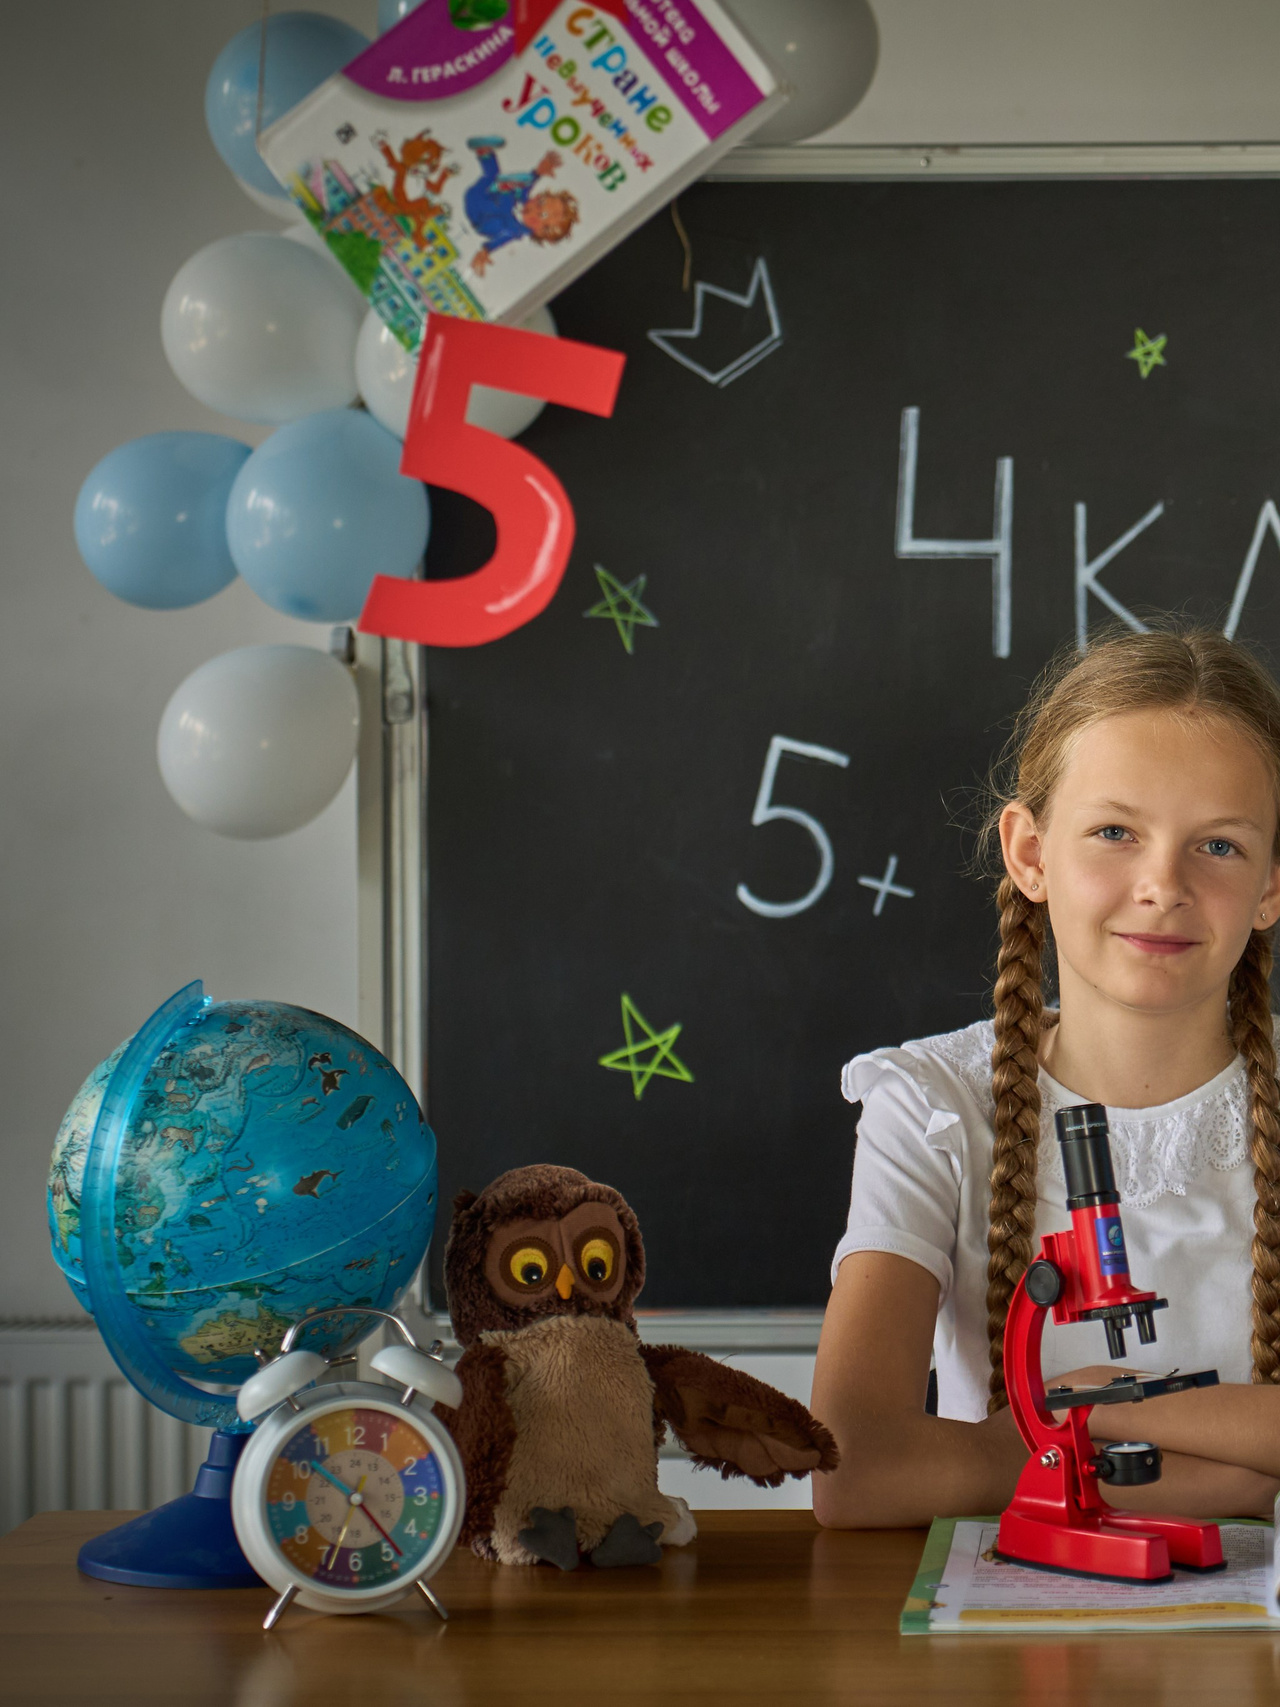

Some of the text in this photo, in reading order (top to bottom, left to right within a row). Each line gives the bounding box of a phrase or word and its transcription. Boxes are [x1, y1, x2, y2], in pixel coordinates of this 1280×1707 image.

[411, 25, 514, 85] ГЕРАСКИНА
[664, 46, 721, 115] школы
[357, 310, 627, 648] 5
[895, 406, 1014, 659] 4
[343, 1426, 366, 1445] 12
[380, 1432, 388, 1452] 1
[314, 1437, 330, 1455] 11
[292, 1460, 311, 1479] 10
[349, 1459, 362, 1469] 24
[367, 1462, 379, 1472] 13
[404, 1457, 418, 1476] 2
[379, 1476, 391, 1486] 14
[282, 1492, 296, 1511] 9
[315, 1496, 325, 1505] 21
[385, 1493, 396, 1502] 15
[413, 1486, 428, 1506] 3
[320, 1514, 332, 1523] 20
[380, 1509, 392, 1519] 16
[294, 1525, 309, 1545] 8
[350, 1528, 361, 1538] 18
[404, 1518, 418, 1538] 4
[317, 1546, 331, 1565] 7
[381, 1542, 395, 1562] 5
[348, 1552, 363, 1572] 6
